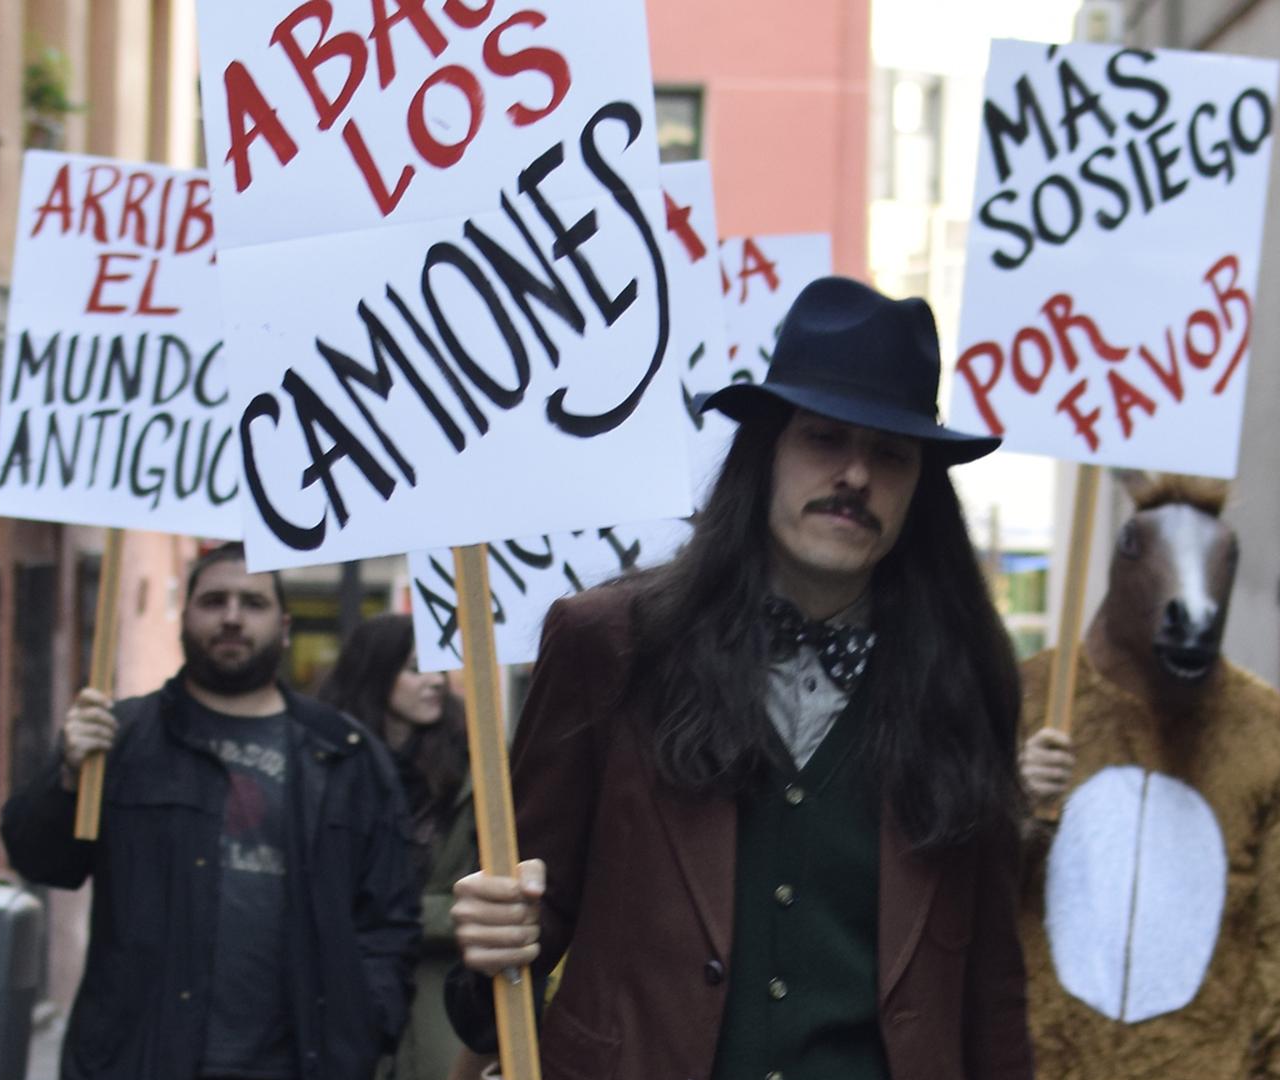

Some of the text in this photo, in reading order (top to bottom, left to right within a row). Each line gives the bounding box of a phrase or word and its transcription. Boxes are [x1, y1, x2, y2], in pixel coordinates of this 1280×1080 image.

[342, 10, 572, 217] LOS
[978, 87, 1274, 271] SOSIEGO
[31, 162, 217, 264] ARRIB
[85, 252, 183, 316] EL
[240, 100, 669, 551] CAMIONES
[955, 293, 1130, 437] POR
[1056, 254, 1253, 453] FAVOR
